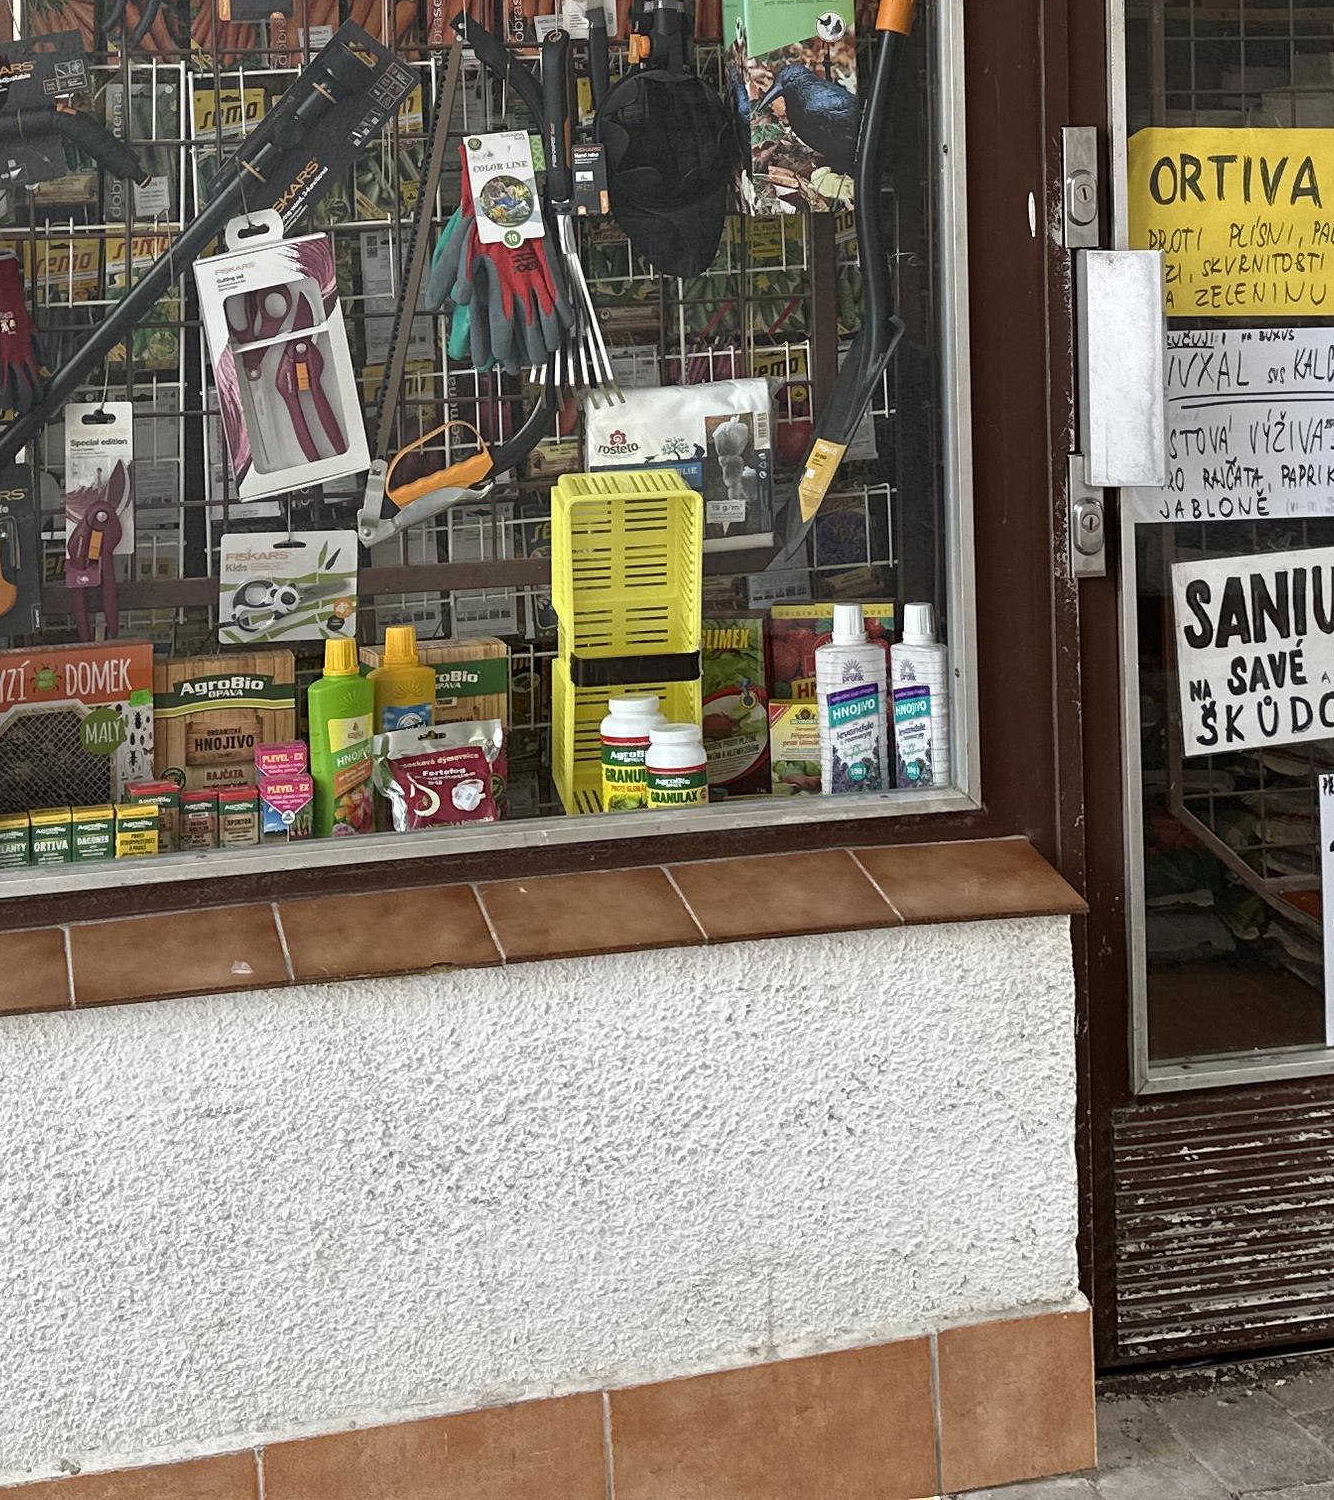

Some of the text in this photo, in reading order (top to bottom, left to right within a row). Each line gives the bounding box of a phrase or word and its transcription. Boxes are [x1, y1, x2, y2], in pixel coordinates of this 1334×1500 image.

[473, 161, 528, 173] COLOR LINE
[1150, 153, 1322, 208] ORTIVA
[508, 233, 518, 242] 10
[1149, 227, 1202, 253] PROTI
[1195, 282, 1327, 308] ZELENINU
[1241, 332, 1252, 342] NA
[1169, 409, 1323, 459] STOVÁ VÝŽIVA
[71, 437, 127, 448] Special edition
[1159, 488, 1270, 518] JABLONĚ
[225, 551, 289, 561] FISKARS
[225, 563, 248, 572] Kids
[1189, 679, 1212, 701] NA
[1228, 639, 1307, 695] SAVÉ
[1321, 671, 1331, 683] A
[65, 658, 132, 696] DOMEK
[180, 677, 263, 696] AgroBio
[208, 688, 243, 698] OPAVA
[833, 699, 875, 719] HNOJIVO
[896, 701, 926, 715] HNOJIVO
[85, 717, 124, 745] MALÝ
[195, 735, 254, 752] HNOJIVO
[262, 754, 289, 763] PLEVEL
[206, 769, 243, 781] RAJČATA
[267, 785, 294, 794] PLEVEL
[651, 790, 698, 803] GRANULAX
[34, 840, 68, 852] ORTIVA
